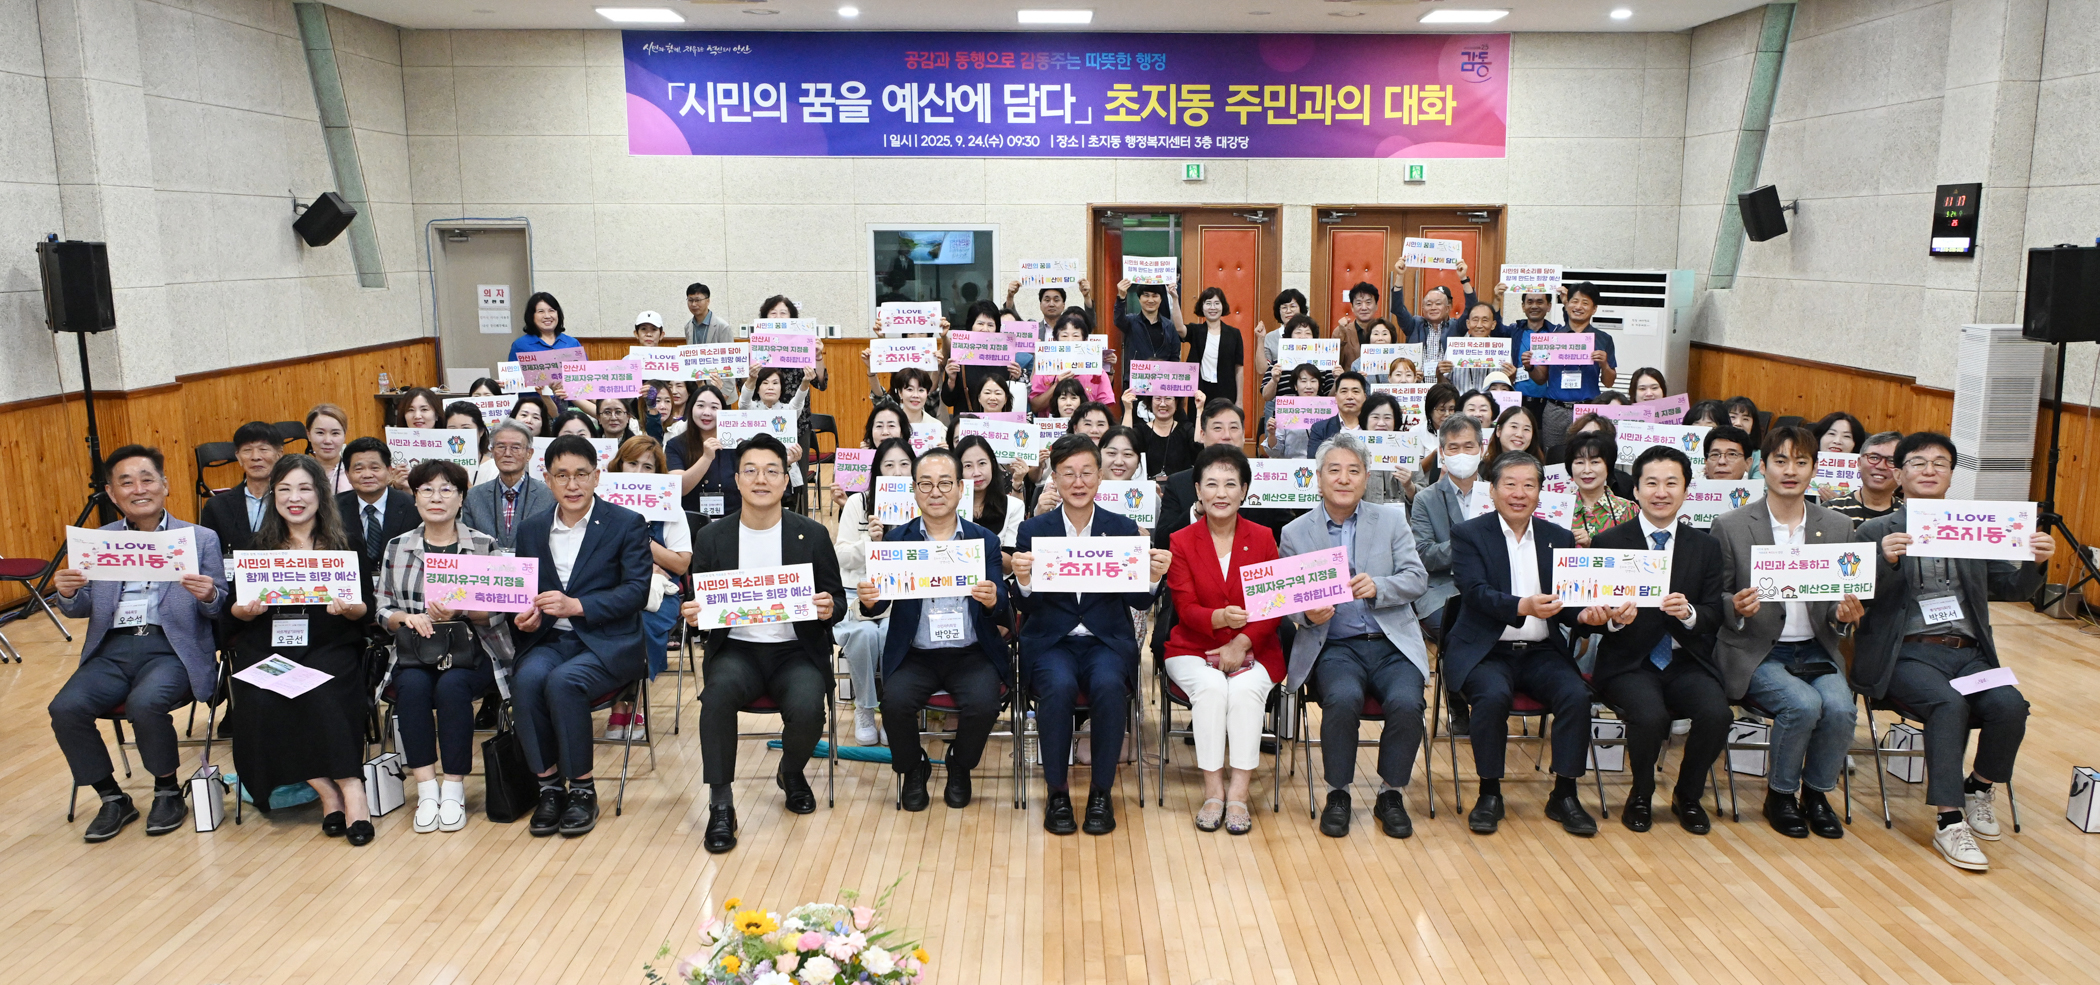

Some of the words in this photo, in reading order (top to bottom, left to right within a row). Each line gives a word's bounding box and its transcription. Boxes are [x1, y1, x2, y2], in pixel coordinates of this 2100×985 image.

[905, 51, 950, 70] 공감과
[955, 51, 1015, 70] 동행으로
[1020, 52, 1081, 70] 감동주는
[1086, 52, 1132, 71] 따뜻한
[1136, 52, 1166, 71] 행정
[668, 81, 788, 123] 「시민의
[799, 81, 872, 123] 꿈을
[882, 83, 991, 123] 예산에
[1004, 83, 1092, 124] 담다」
[1104, 84, 1214, 127] 초지동
[1225, 84, 1370, 126] 주민과의
[1384, 84, 1457, 126] 대화
[921, 135, 953, 148] 2025.
[955, 135, 965, 147] 9.
[1007, 135, 1040, 147] 09:30
[1088, 135, 1121, 149] 초지동
[1125, 135, 1191, 149] 행정복지센터
[1195, 136, 1212, 149] 3층
[1217, 136, 1249, 149] 대강당
[483, 289, 492, 297] 의
[496, 289, 504, 297] 자
[893, 316, 928, 326] 초지동
[751, 335, 770, 343] 안산시
[952, 342, 988, 350] 경제자유구역
[989, 343, 1008, 351] 지정을
[1037, 345, 1057, 353] 시민의
[1058, 345, 1072, 353] 꿈을
[679, 349, 698, 358] 시민의
[699, 348, 726, 356] 목소리를
[728, 347, 741, 355] 담아
[885, 352, 922, 363] 초지동
[518, 354, 537, 362] 안산시
[684, 358, 698, 366] 함께
[699, 357, 718, 365] 만드는
[720, 356, 734, 364] 희망
[563, 364, 586, 372] 안산시
[644, 361, 680, 371] 초지동
[1085, 361, 1098, 369] 담다
[1131, 363, 1151, 371] 안산시
[564, 373, 609, 382] 경제자유구역
[611, 373, 633, 381] 지정을
[598, 385, 638, 394] 축하합니다.
[740, 420, 767, 428] 소통하고
[1368, 435, 1383, 444] 꿈을
[1619, 432, 1642, 442] 시민과
[1644, 435, 1676, 444] 소통하고
[389, 439, 411, 447] 시민과
[412, 439, 442, 448] 소통하고
[837, 452, 860, 460] 안산시
[1374, 455, 1398, 464] 예산에
[1399, 455, 1415, 464] 담다
[1254, 472, 1288, 481] 소통하고
[1836, 470, 1855, 479] 희망
[621, 483, 652, 491] LOVE
[879, 483, 906, 493] 시민의
[608, 493, 660, 508] 초지동
[1262, 493, 1296, 502] 예산으로
[1685, 493, 1722, 501] 소통하고
[1956, 513, 1996, 522] LOVE
[1936, 525, 2006, 544] 초지동
[115, 542, 156, 551] LOVE
[870, 549, 903, 561] 시민의
[906, 549, 929, 561] 꿈을
[1077, 550, 1113, 558] LOVE
[97, 553, 168, 568] 초지동
[237, 558, 271, 569] 시민의
[274, 558, 319, 569] 목소리를
[322, 558, 344, 568] 담아
[426, 557, 458, 570] 안산시
[1557, 556, 1590, 568] 시민의
[1593, 556, 1616, 568] 꿈을
[1754, 560, 1786, 571] 시민과
[1788, 559, 1830, 570] 소통하고
[1059, 562, 1123, 578] 초지동
[1242, 566, 1274, 581] 안산시
[246, 572, 269, 583] 함께
[272, 571, 306, 582] 만드는
[309, 571, 331, 582] 희망
[334, 571, 357, 581] 예산
[426, 573, 490, 586] 경제자유구역
[493, 574, 525, 587] 지정을
[697, 579, 729, 592] 시민의
[732, 574, 775, 589] 목소리를
[778, 572, 800, 585] 담아
[919, 575, 953, 587] 예산에
[955, 575, 979, 586] 담다
[1245, 575, 1306, 597] 경제자유구역
[1308, 567, 1338, 583] 지정을
[1601, 585, 1636, 596] 예산에
[1639, 585, 1662, 597] 담다
[1798, 583, 1840, 594] 예산으로
[1843, 582, 1872, 595] 답하다
[475, 592, 531, 605] 축하합니다.
[706, 593, 728, 605] 함께
[730, 591, 763, 603] 만드는
[766, 587, 788, 600] 희망
[790, 585, 812, 597] 예산
[1293, 584, 1345, 604] 축하합니다.
[276, 635, 303, 645] 오금선
